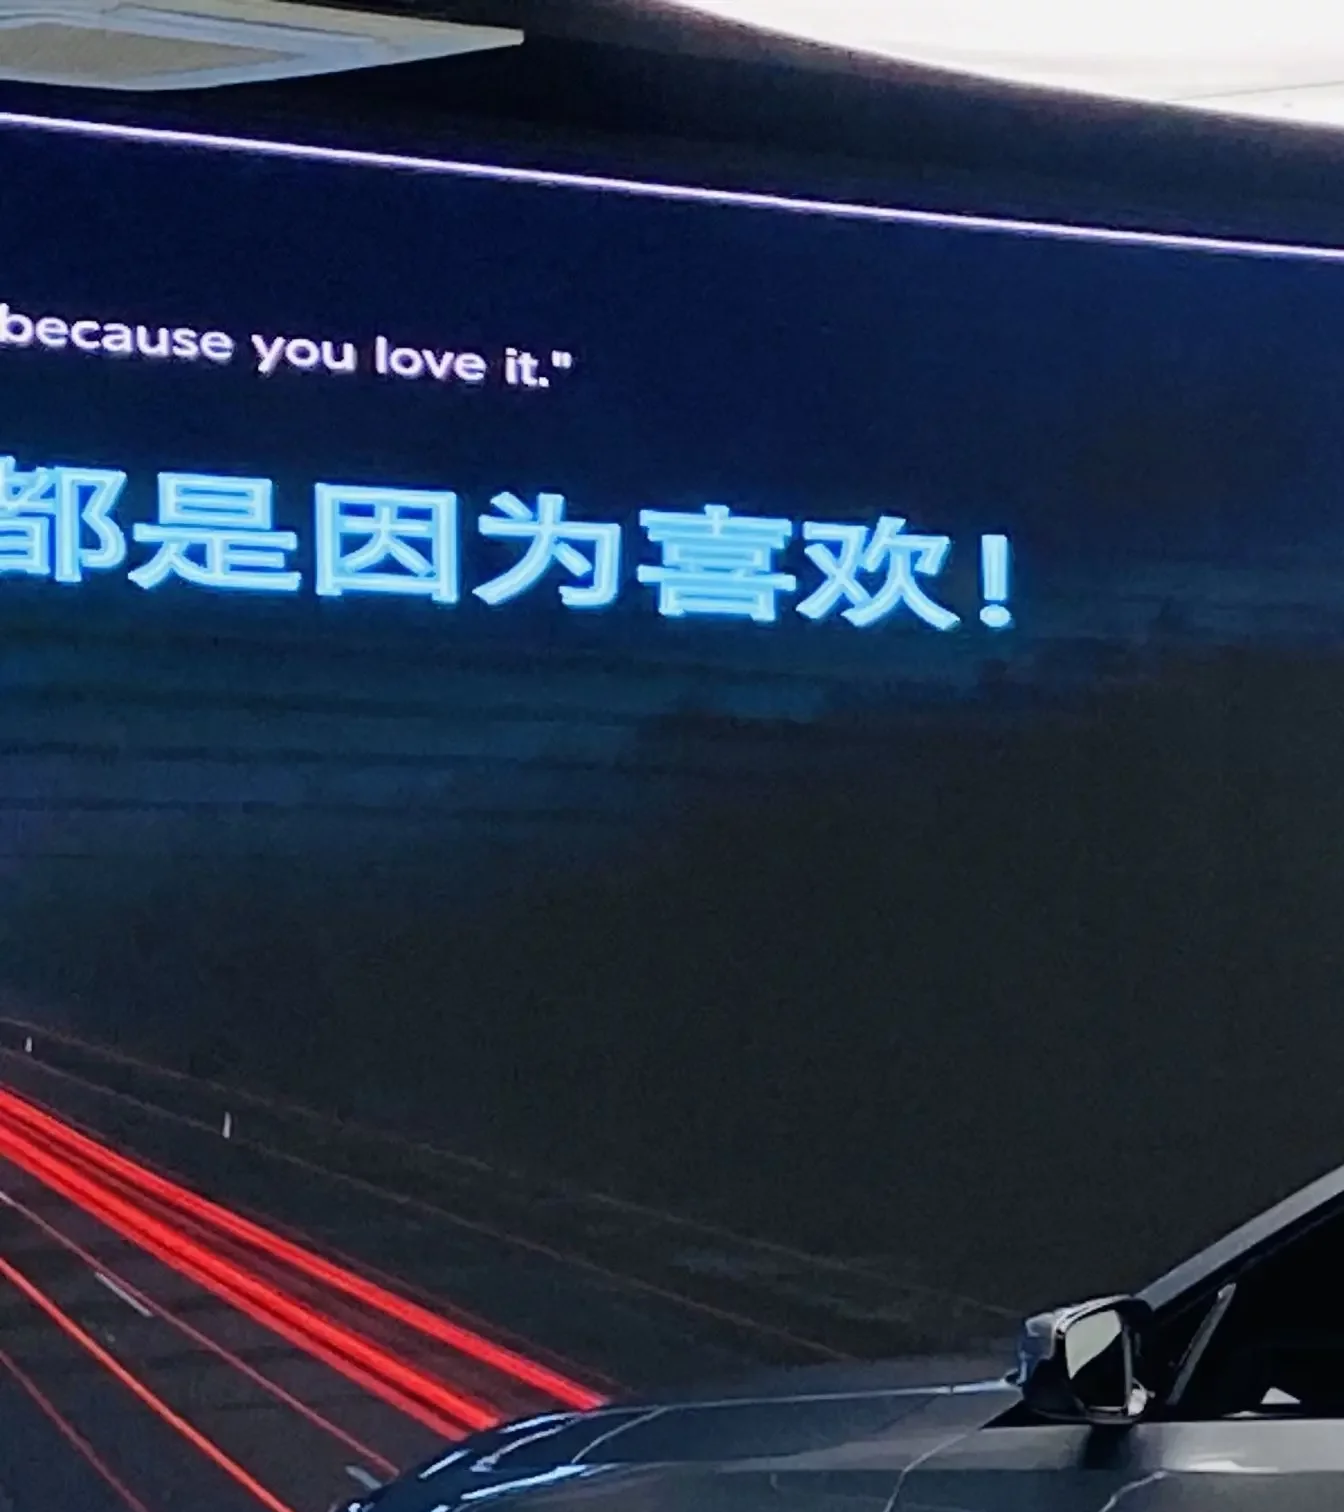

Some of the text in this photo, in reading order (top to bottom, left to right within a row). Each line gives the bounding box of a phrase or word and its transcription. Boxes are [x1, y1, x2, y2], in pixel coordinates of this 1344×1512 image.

[0, 304, 573, 389] because you love it."
